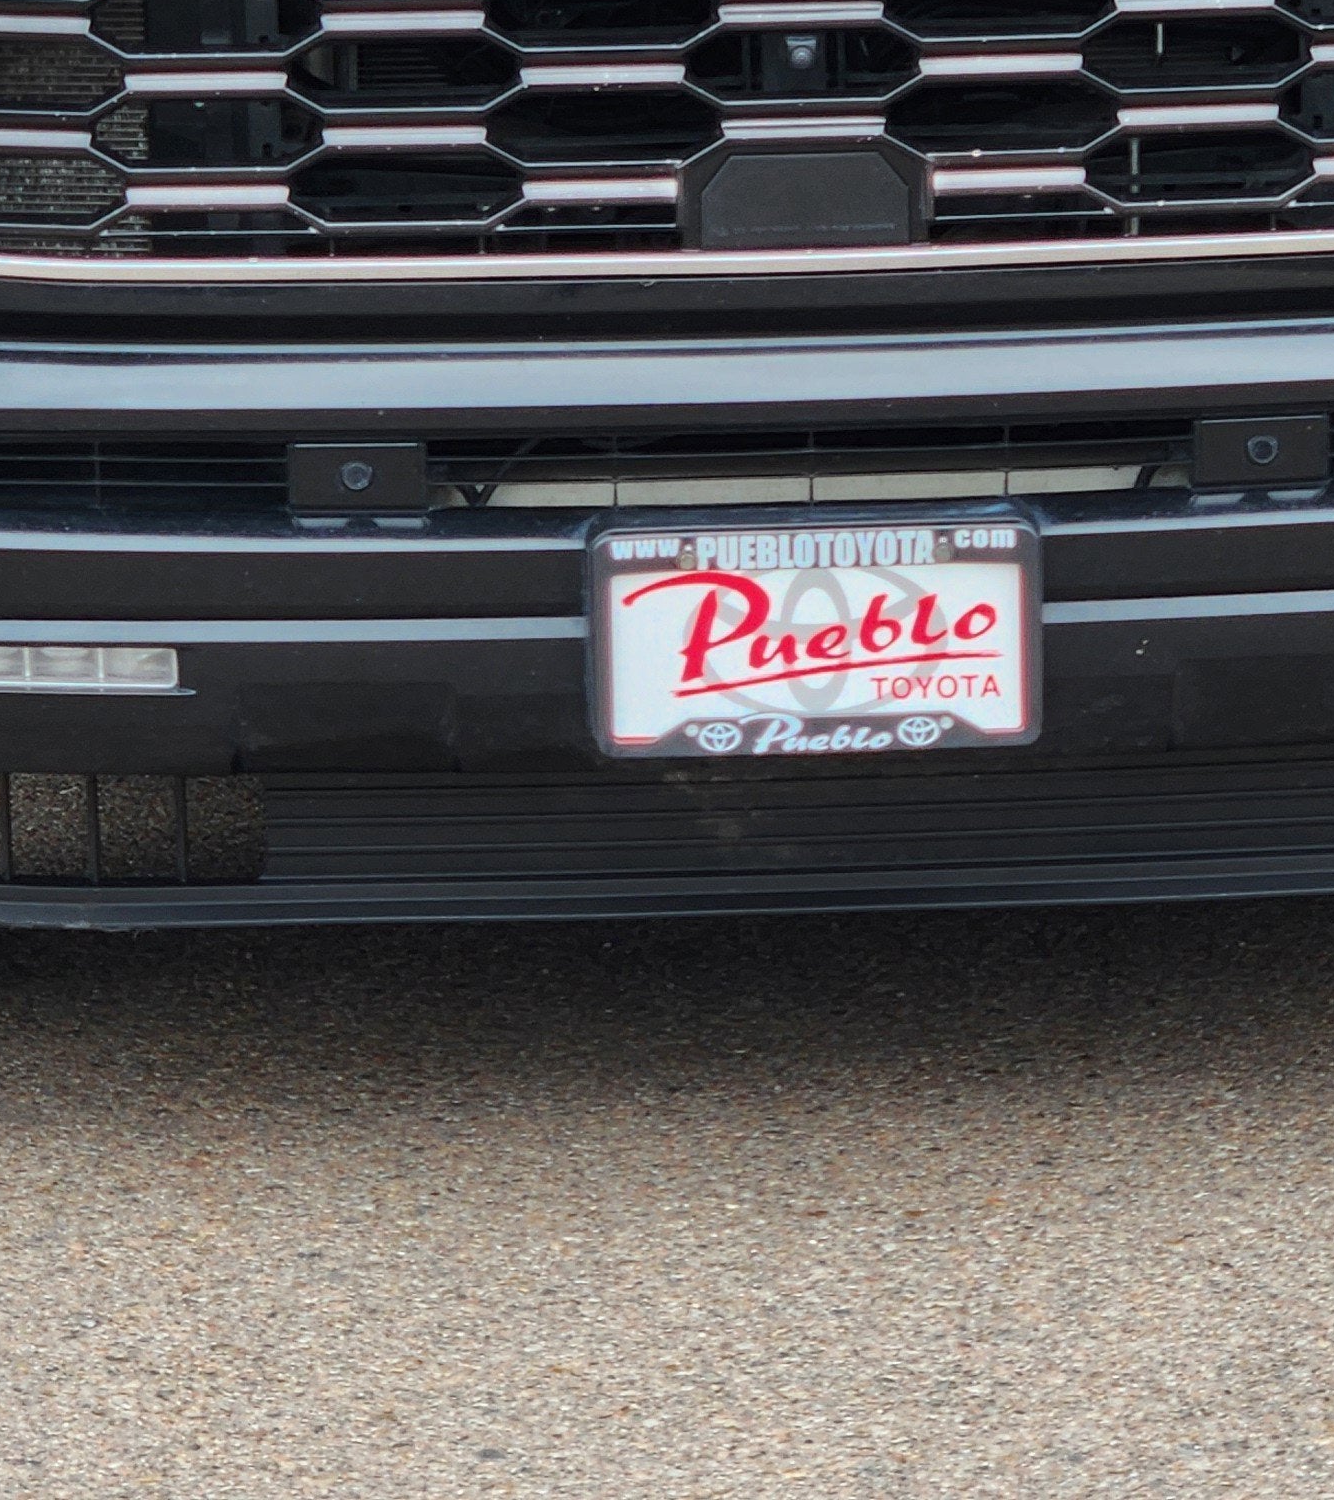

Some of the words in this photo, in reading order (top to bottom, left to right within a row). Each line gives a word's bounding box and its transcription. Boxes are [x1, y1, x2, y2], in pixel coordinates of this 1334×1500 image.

[622, 570, 998, 683] Pueblo
[872, 674, 1001, 700] TOYOTA
[739, 712, 893, 755] Pueblo
